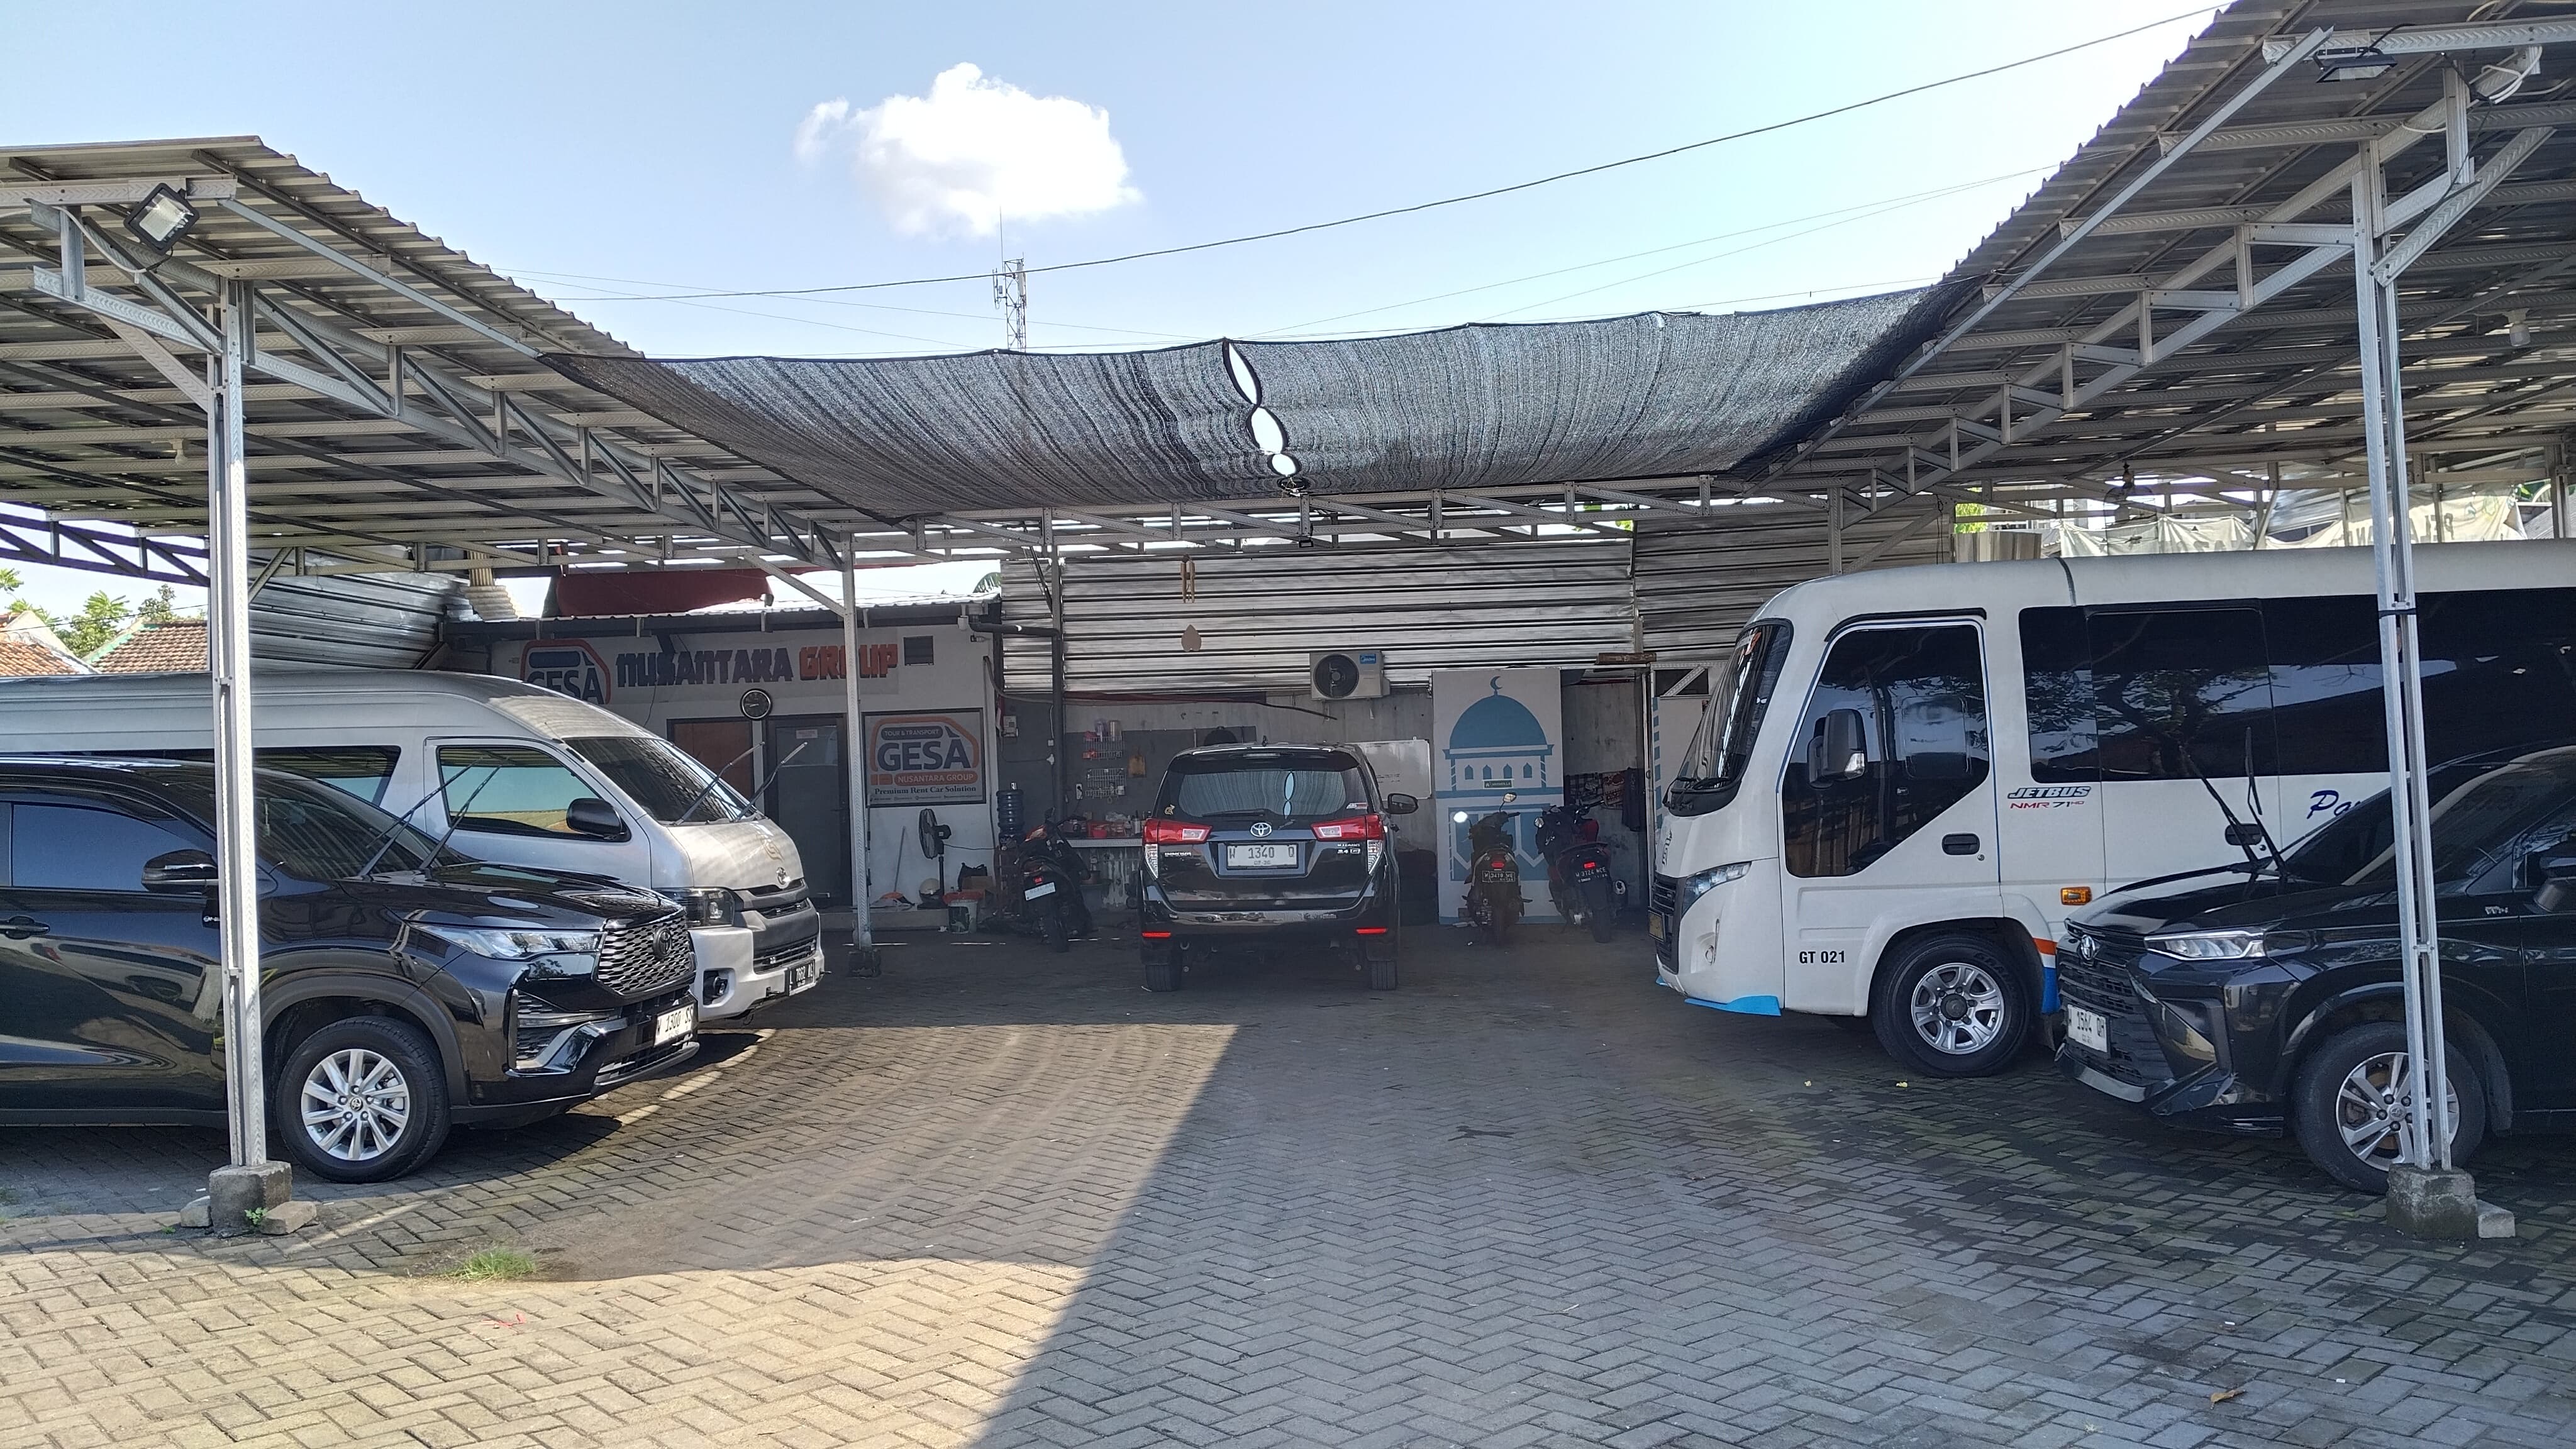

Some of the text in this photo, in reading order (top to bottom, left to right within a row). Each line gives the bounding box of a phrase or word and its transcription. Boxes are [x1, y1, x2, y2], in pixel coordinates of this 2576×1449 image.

[616, 647, 794, 687] NUSANTARA
[877, 739, 971, 771] GESA
[897, 775, 944, 784] NUSANTARA
[2007, 786, 2091, 799] JETBUS
[1229, 846, 1294, 859] W 1340 Q
[1799, 950, 1845, 963] GT 021
[2077, 1011, 2092, 1033] 1564
